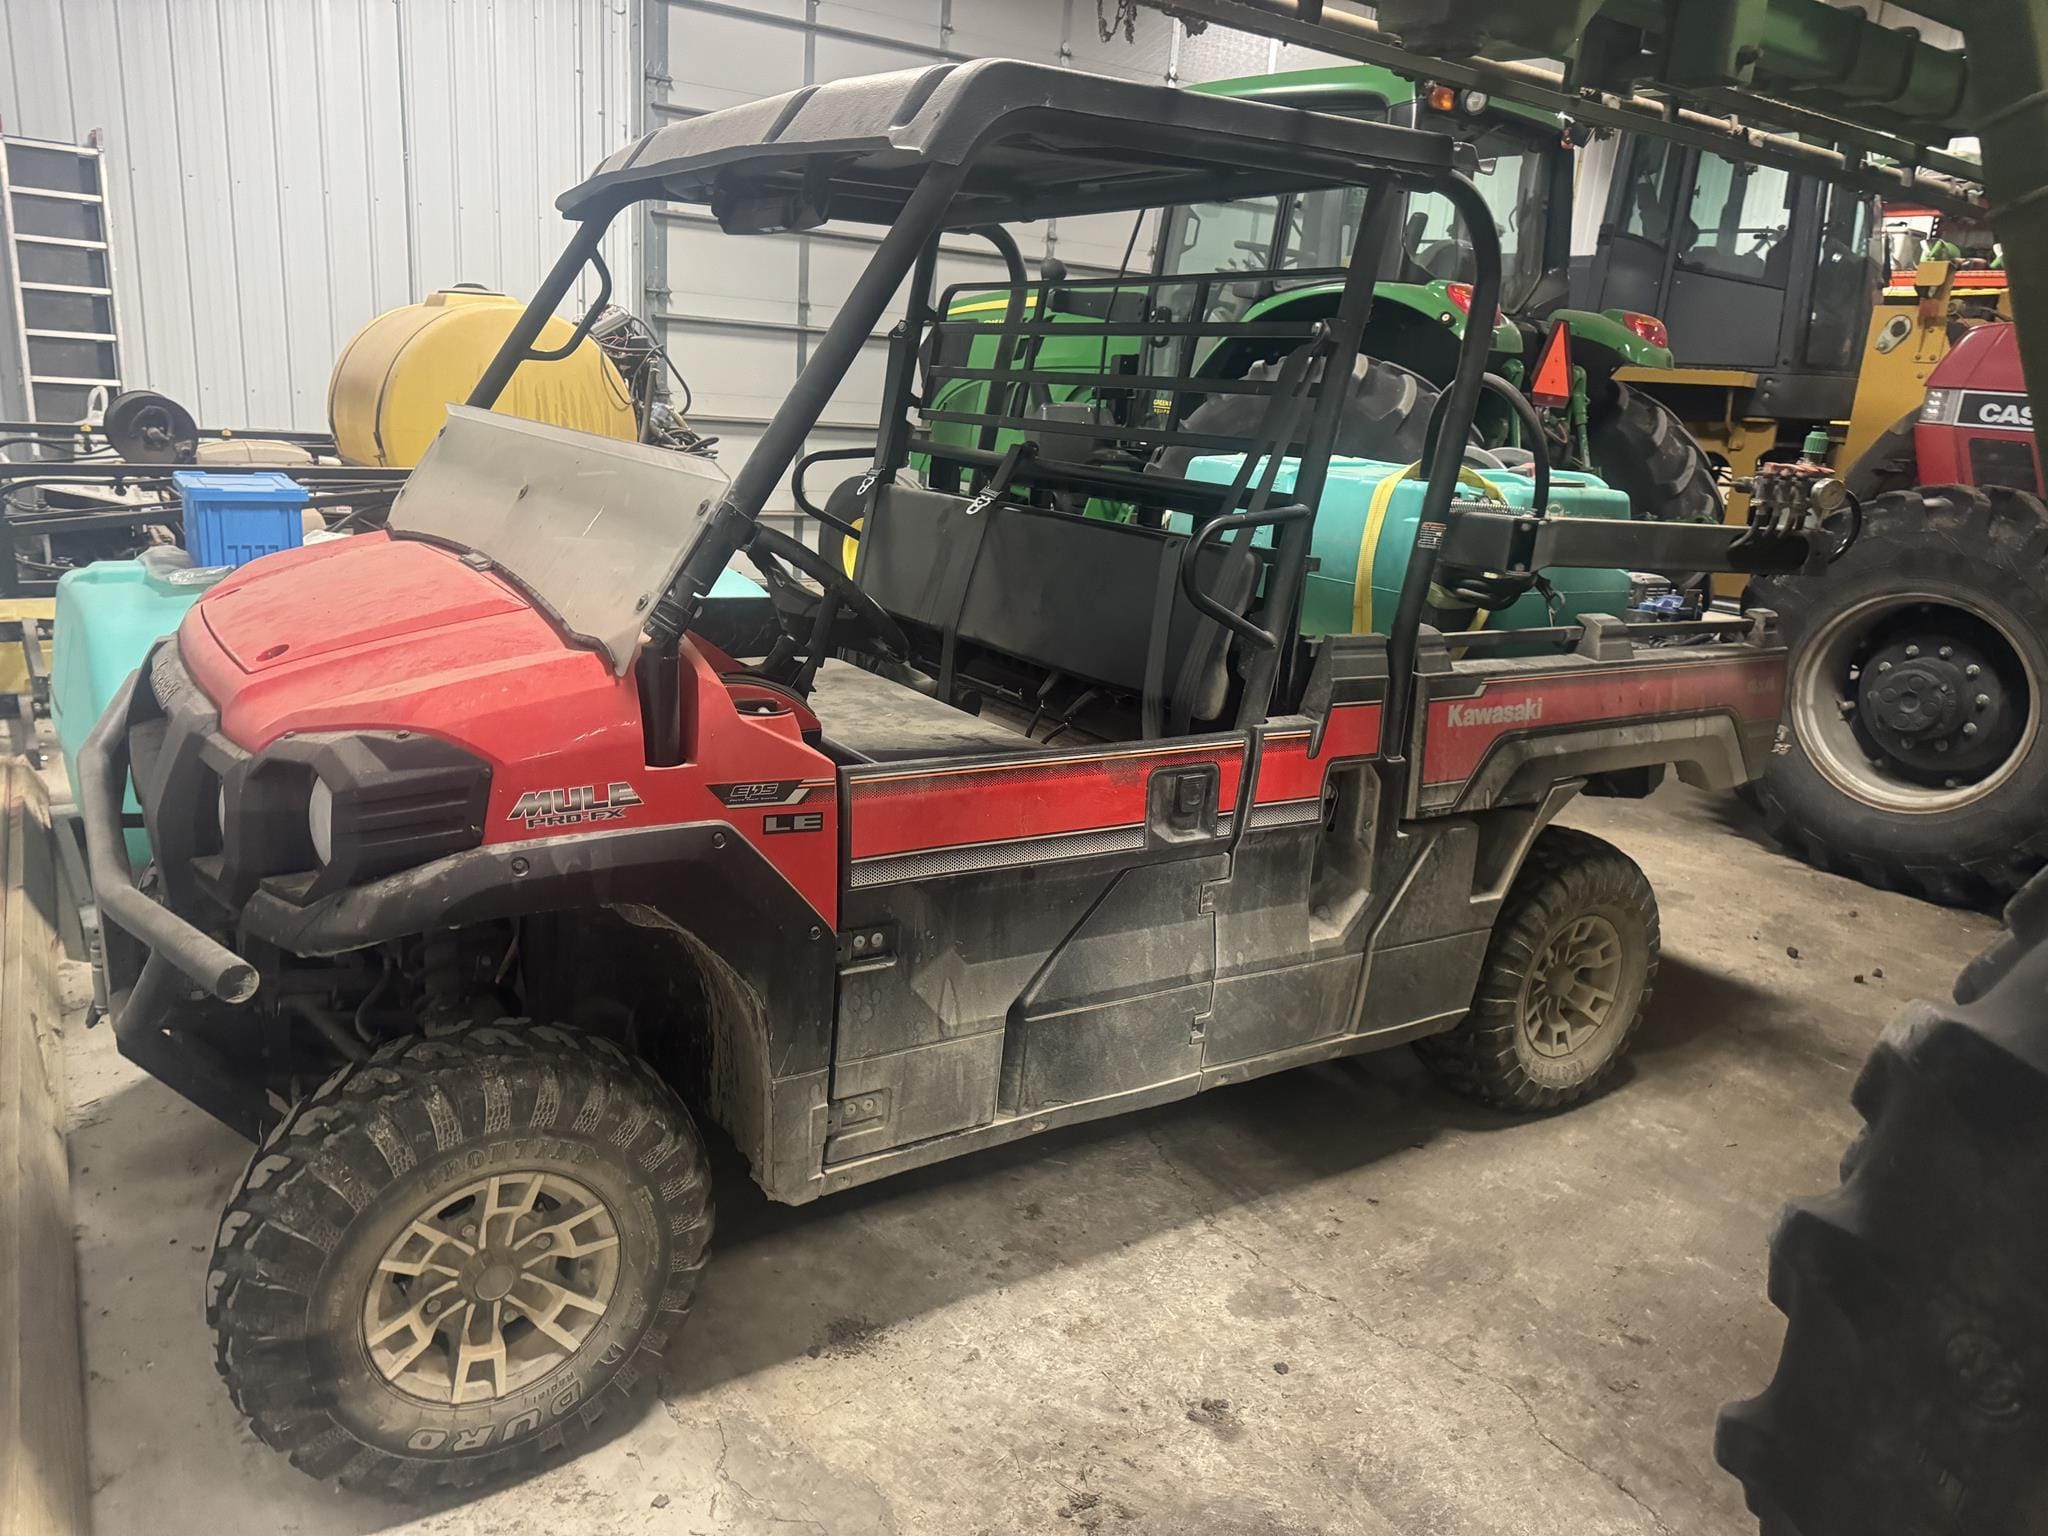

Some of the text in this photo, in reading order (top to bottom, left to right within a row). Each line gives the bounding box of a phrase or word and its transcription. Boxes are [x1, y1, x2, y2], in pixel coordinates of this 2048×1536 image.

[1447, 697, 1543, 727] Kawasaki
[506, 782, 643, 820] MULE
[526, 807, 628, 829] PRO-FX
[765, 814, 823, 832] LE
[407, 1380, 580, 1451] DURO
